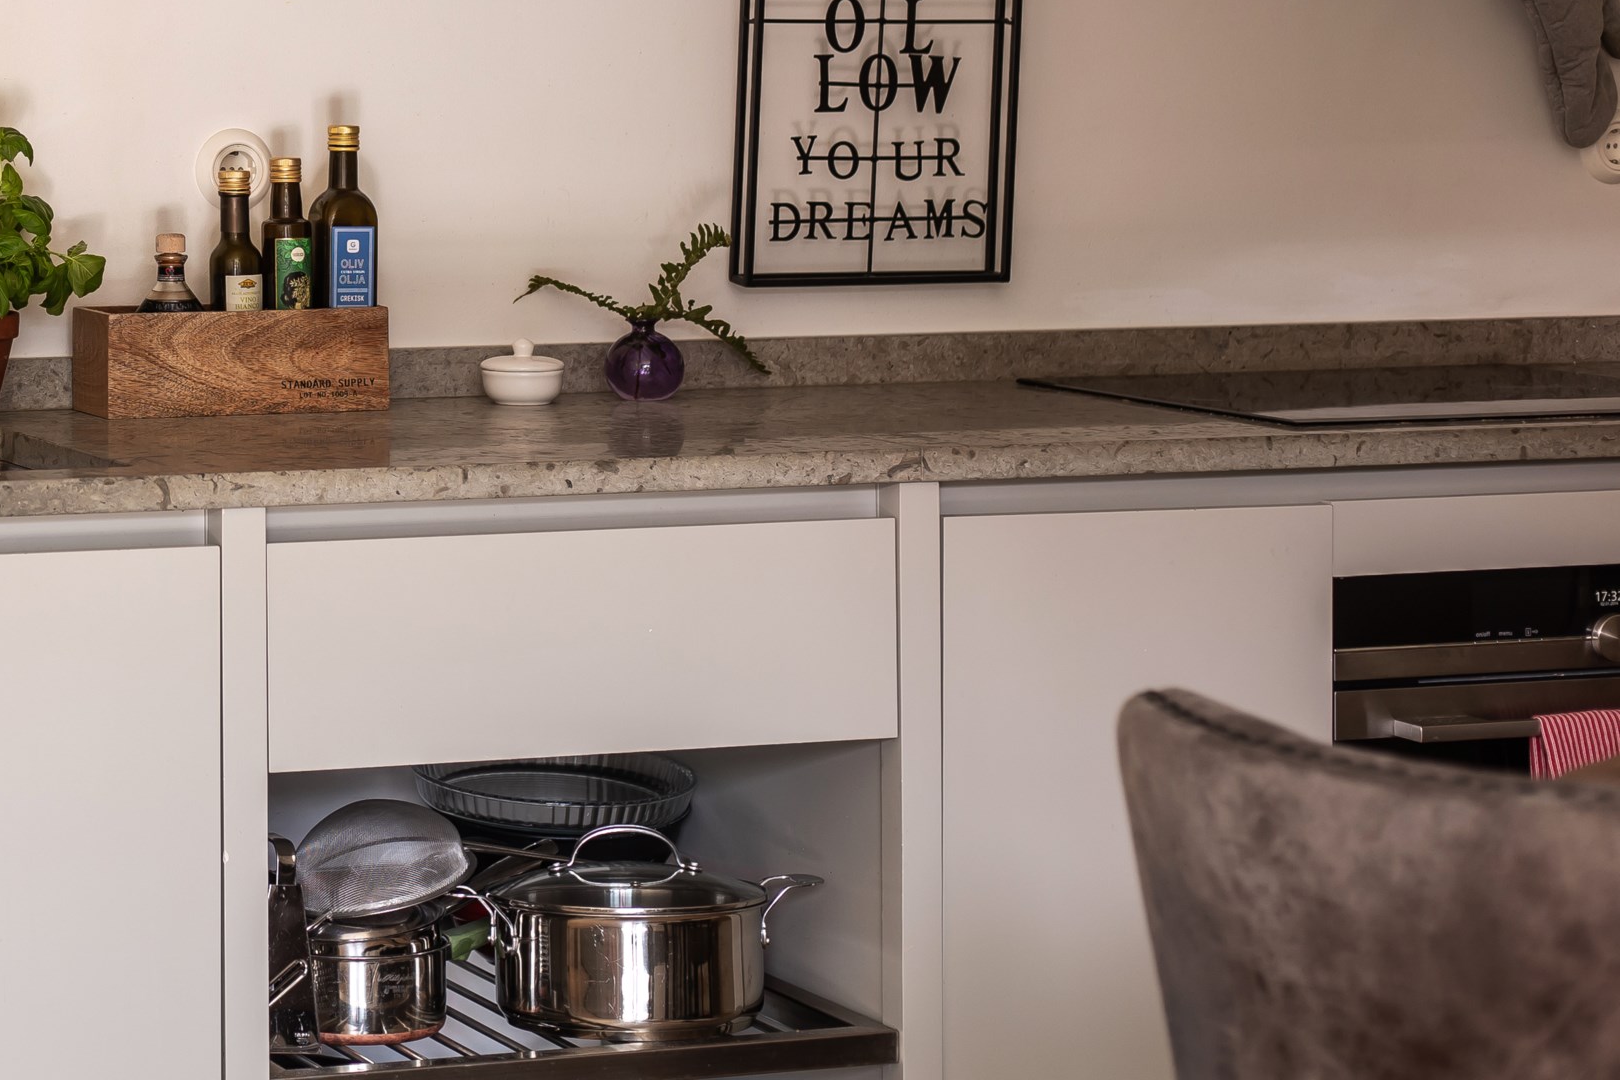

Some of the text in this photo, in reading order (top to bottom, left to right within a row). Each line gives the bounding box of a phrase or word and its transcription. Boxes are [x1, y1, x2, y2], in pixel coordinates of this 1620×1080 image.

[813, 54, 962, 114] LOW
[769, 199, 989, 242] DREAMS
[340, 258, 364, 269] OLIV
[339, 274, 366, 285] OLJA
[280, 377, 375, 389] STANDARD SUPPLY
